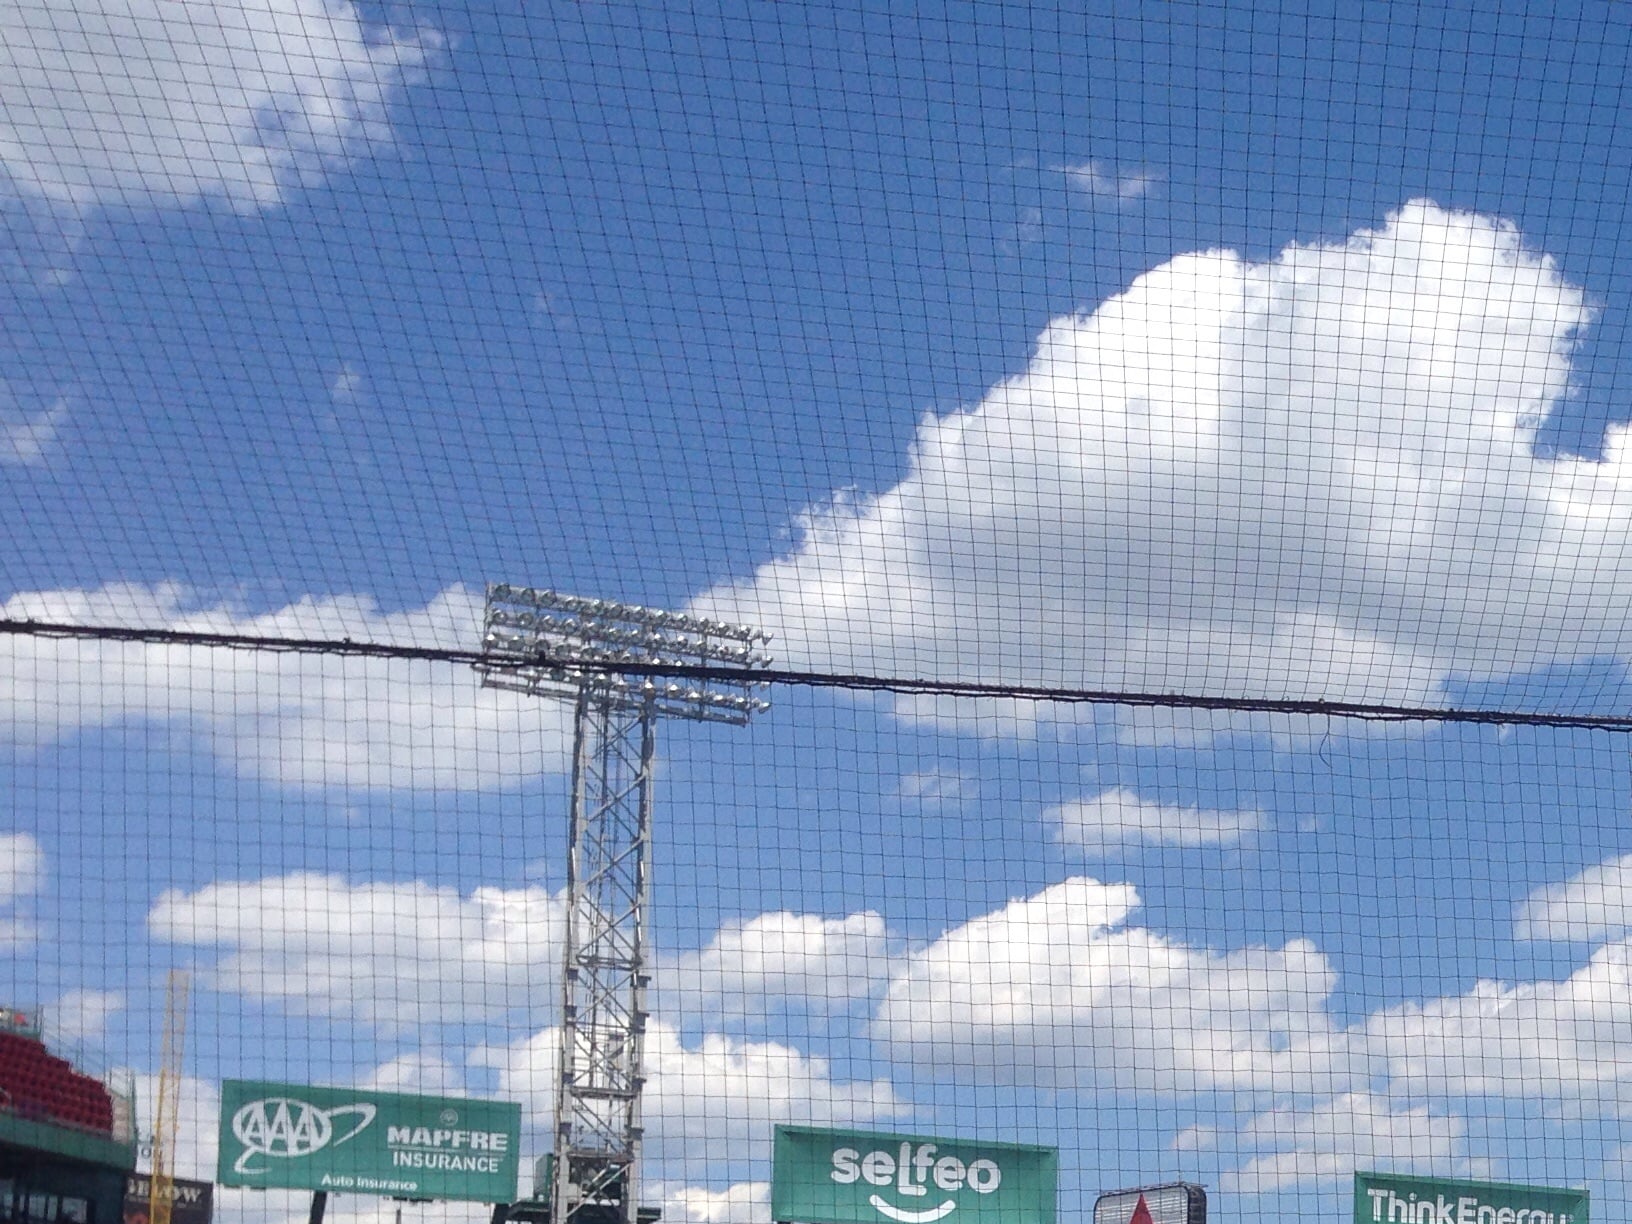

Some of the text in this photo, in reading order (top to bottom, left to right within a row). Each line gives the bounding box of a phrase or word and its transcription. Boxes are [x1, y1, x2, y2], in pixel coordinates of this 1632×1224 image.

[387, 1125, 508, 1151] MAPFRE
[393, 1151, 500, 1173] INSURANCE
[321, 1172, 418, 1192] Auto Insurance
